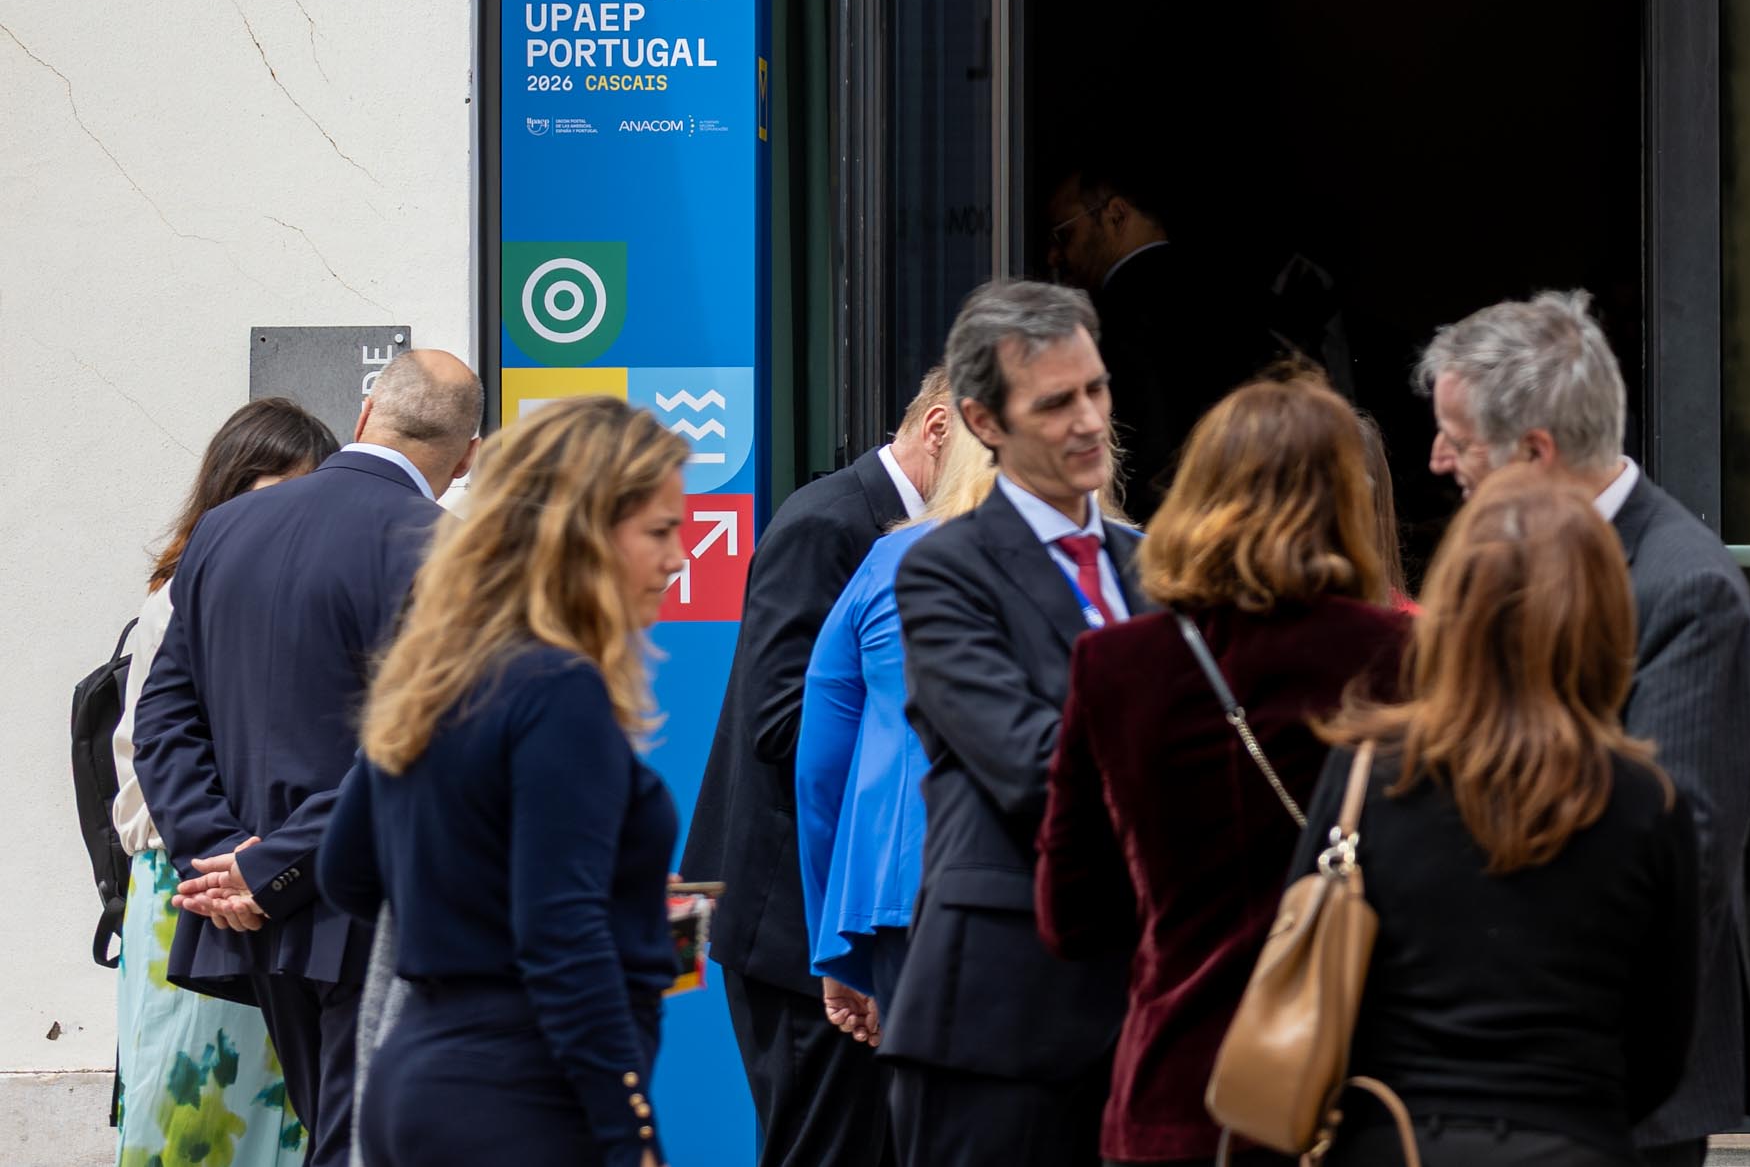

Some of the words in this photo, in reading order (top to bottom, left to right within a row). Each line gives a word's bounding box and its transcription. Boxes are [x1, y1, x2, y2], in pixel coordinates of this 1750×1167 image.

[526, 3, 645, 32] UPAEP
[527, 38, 717, 67] PORTUGAL
[528, 75, 573, 91] 2026
[586, 75, 667, 90] CASCAIS
[619, 120, 683, 132] ANACOM
